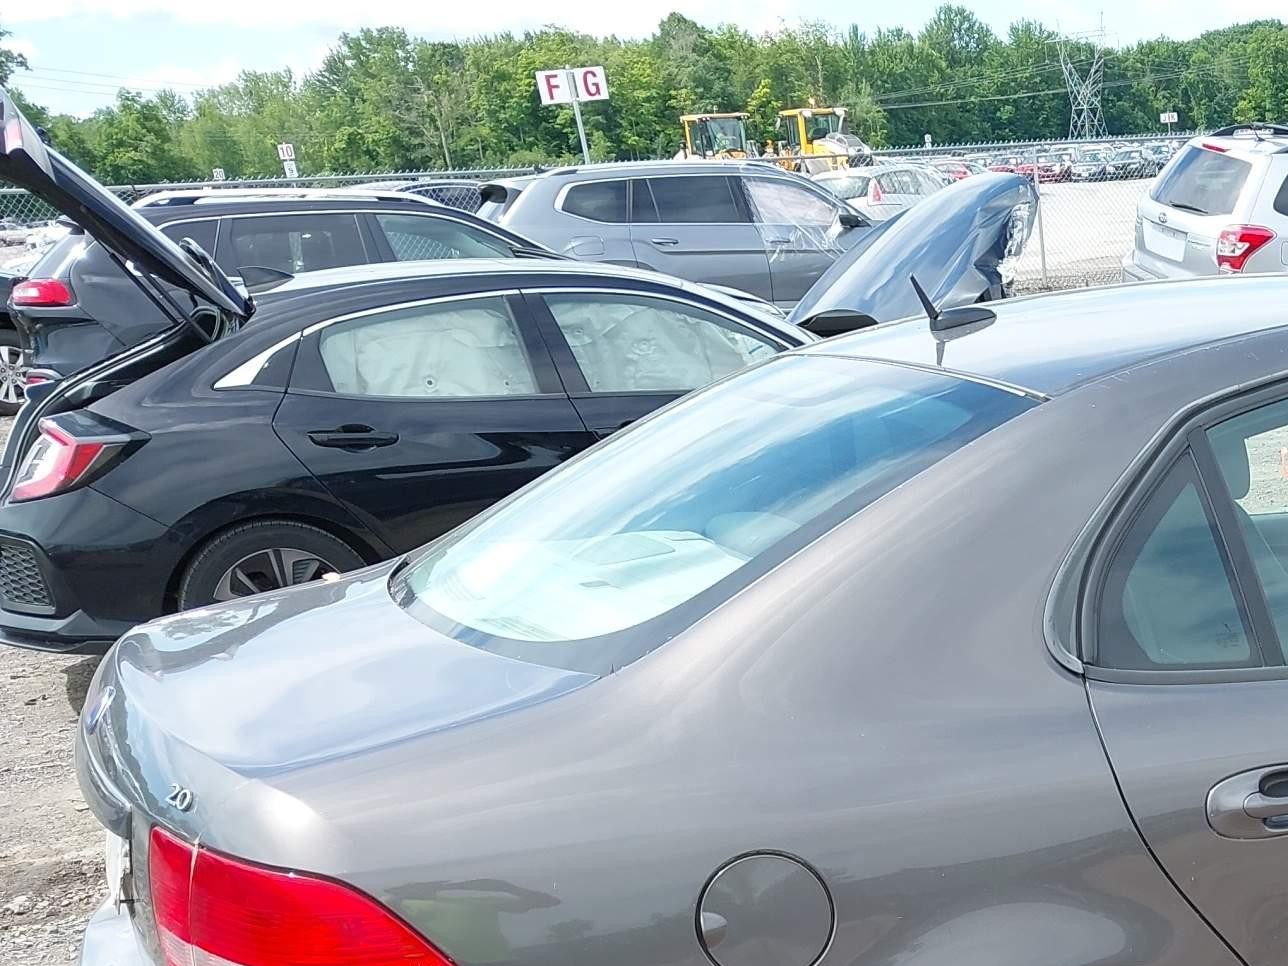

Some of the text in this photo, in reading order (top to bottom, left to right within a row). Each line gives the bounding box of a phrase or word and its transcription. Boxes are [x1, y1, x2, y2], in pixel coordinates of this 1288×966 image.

[544, 70, 601, 100] F G
[280, 145, 293, 157] 10
